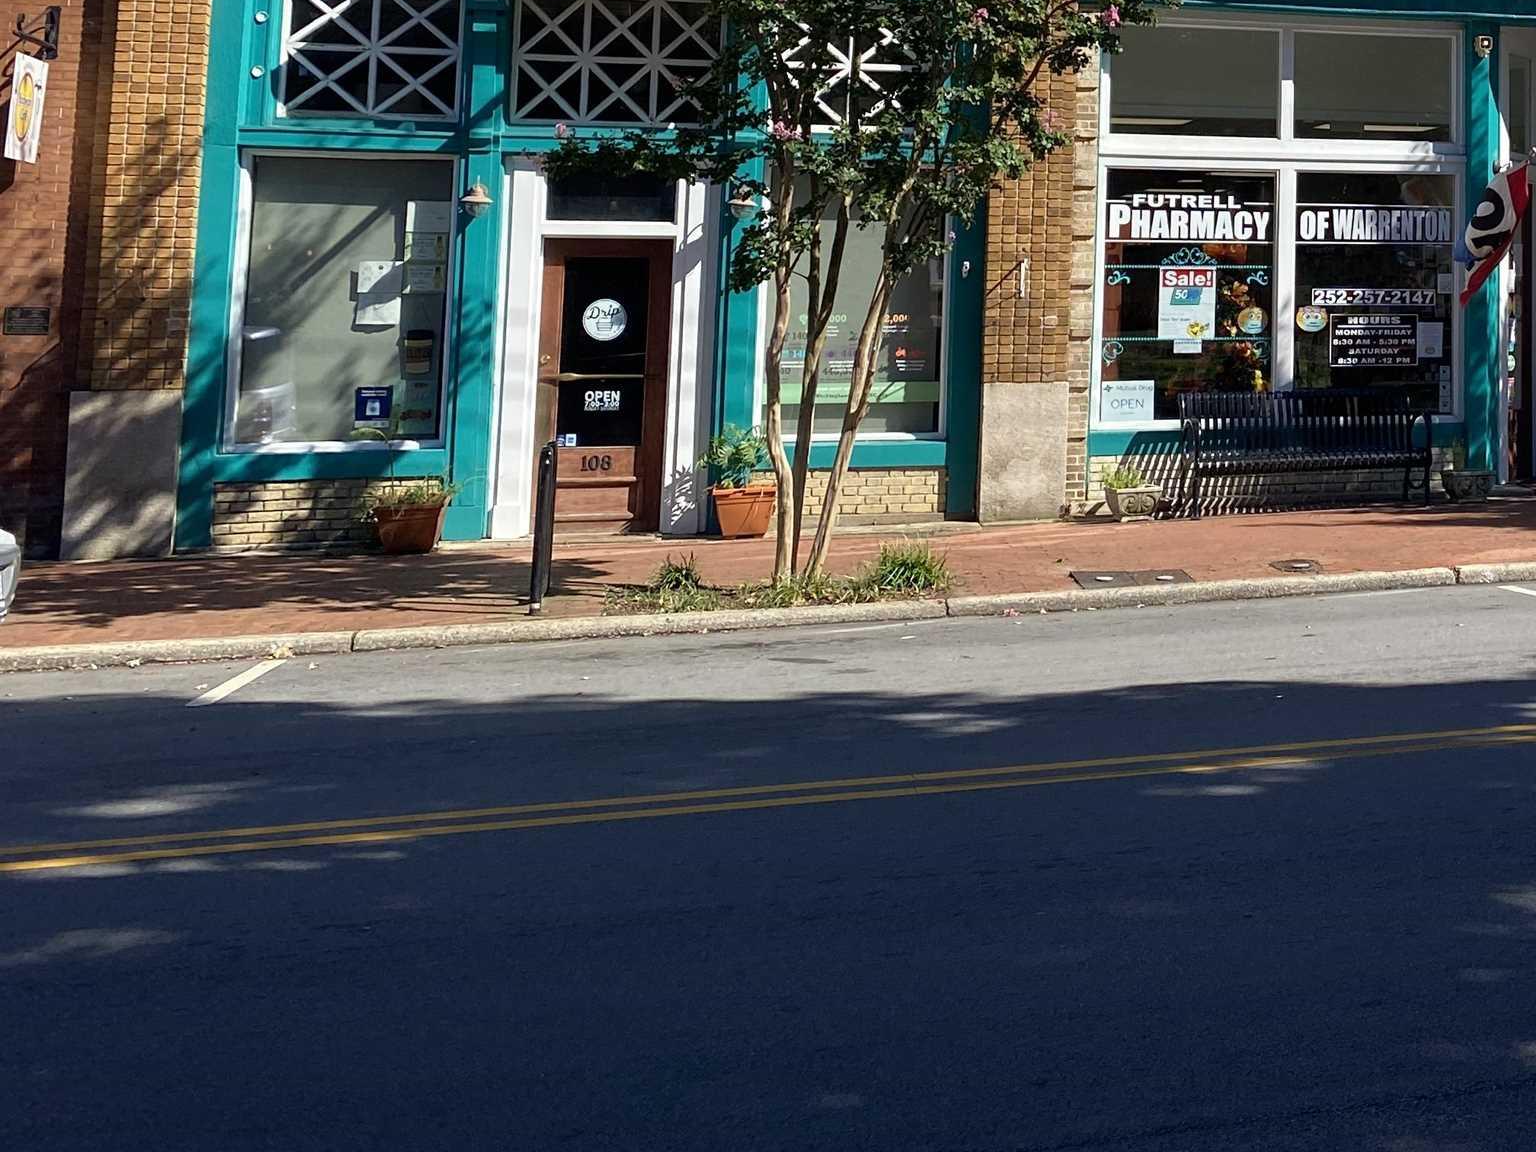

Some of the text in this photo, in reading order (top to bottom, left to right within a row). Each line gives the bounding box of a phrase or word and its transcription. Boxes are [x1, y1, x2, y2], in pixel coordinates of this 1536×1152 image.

[1132, 193, 1242, 209] FUTRELL
[1108, 203, 1450, 241] PHARMACY OF WARRENTON
[1164, 270, 1212, 286] Sale!
[1314, 290, 1434, 304] 252-257-2147
[587, 304, 622, 319] Drip
[1347, 316, 1401, 325] HOURS
[1332, 338, 1353, 346] 8:30
[584, 390, 620, 402] OPEN
[1110, 398, 1145, 409] OPEN
[580, 454, 612, 471] 108
